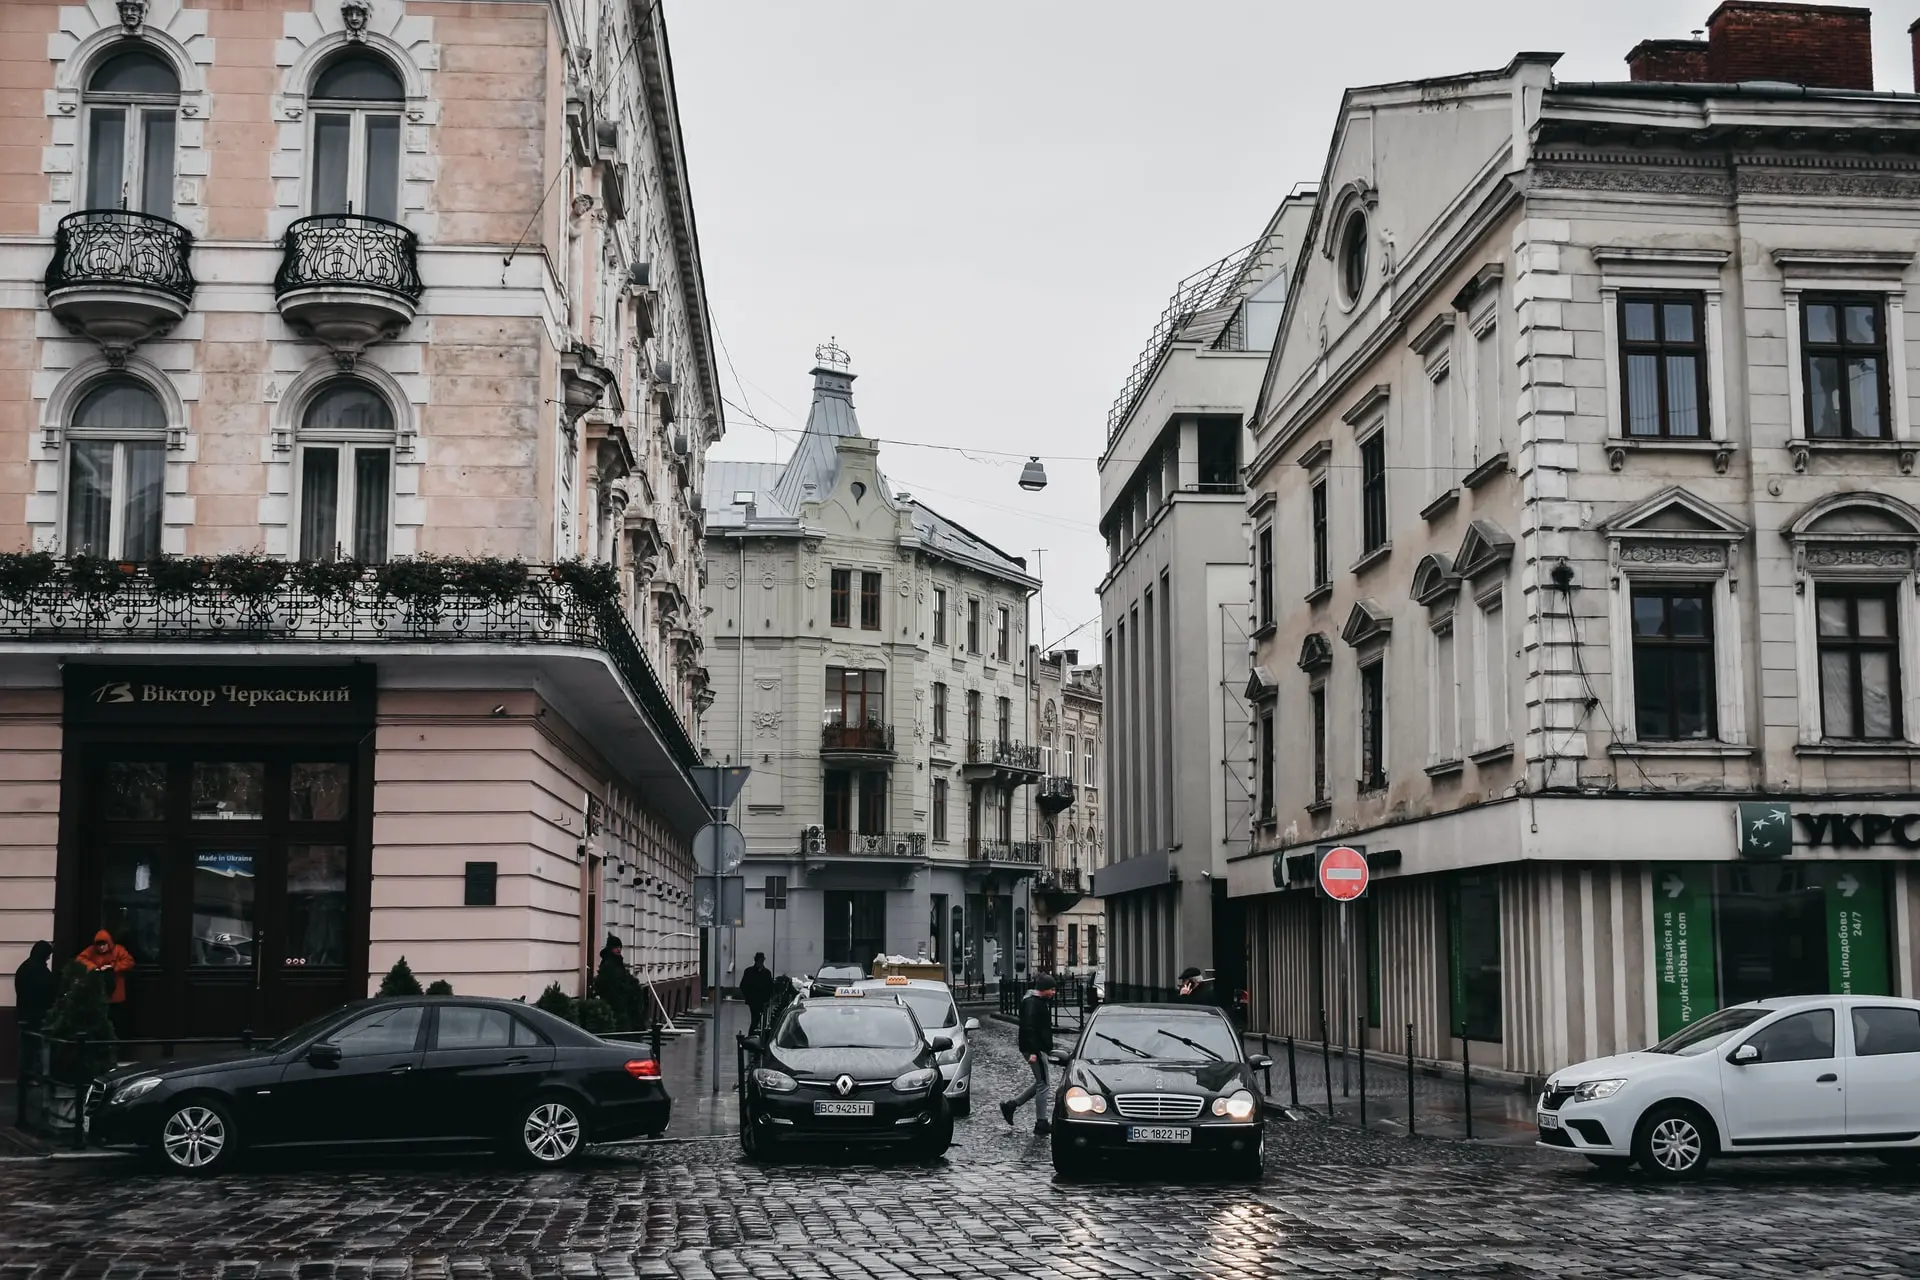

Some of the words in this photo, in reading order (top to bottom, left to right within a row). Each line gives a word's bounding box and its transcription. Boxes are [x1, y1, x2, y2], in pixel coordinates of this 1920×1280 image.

[141, 684, 216, 706] Віктор
[220, 684, 350, 707] Черкаський
[226, 854, 253, 862] Ukraine
[1664, 911, 1672, 926] на
[1852, 911, 1863, 937] 24/7
[1838, 911, 1852, 978] цілодобово
[1663, 930, 1676, 984] Дізнайся
[820, 1103, 834, 1113] BC
[835, 1104, 857, 1114] 9425
[858, 1104, 870, 1114] HI
[1133, 1128, 1148, 1139] BC
[1151, 1129, 1173, 1140] 1822
[1174, 1129, 1190, 1140] HP
